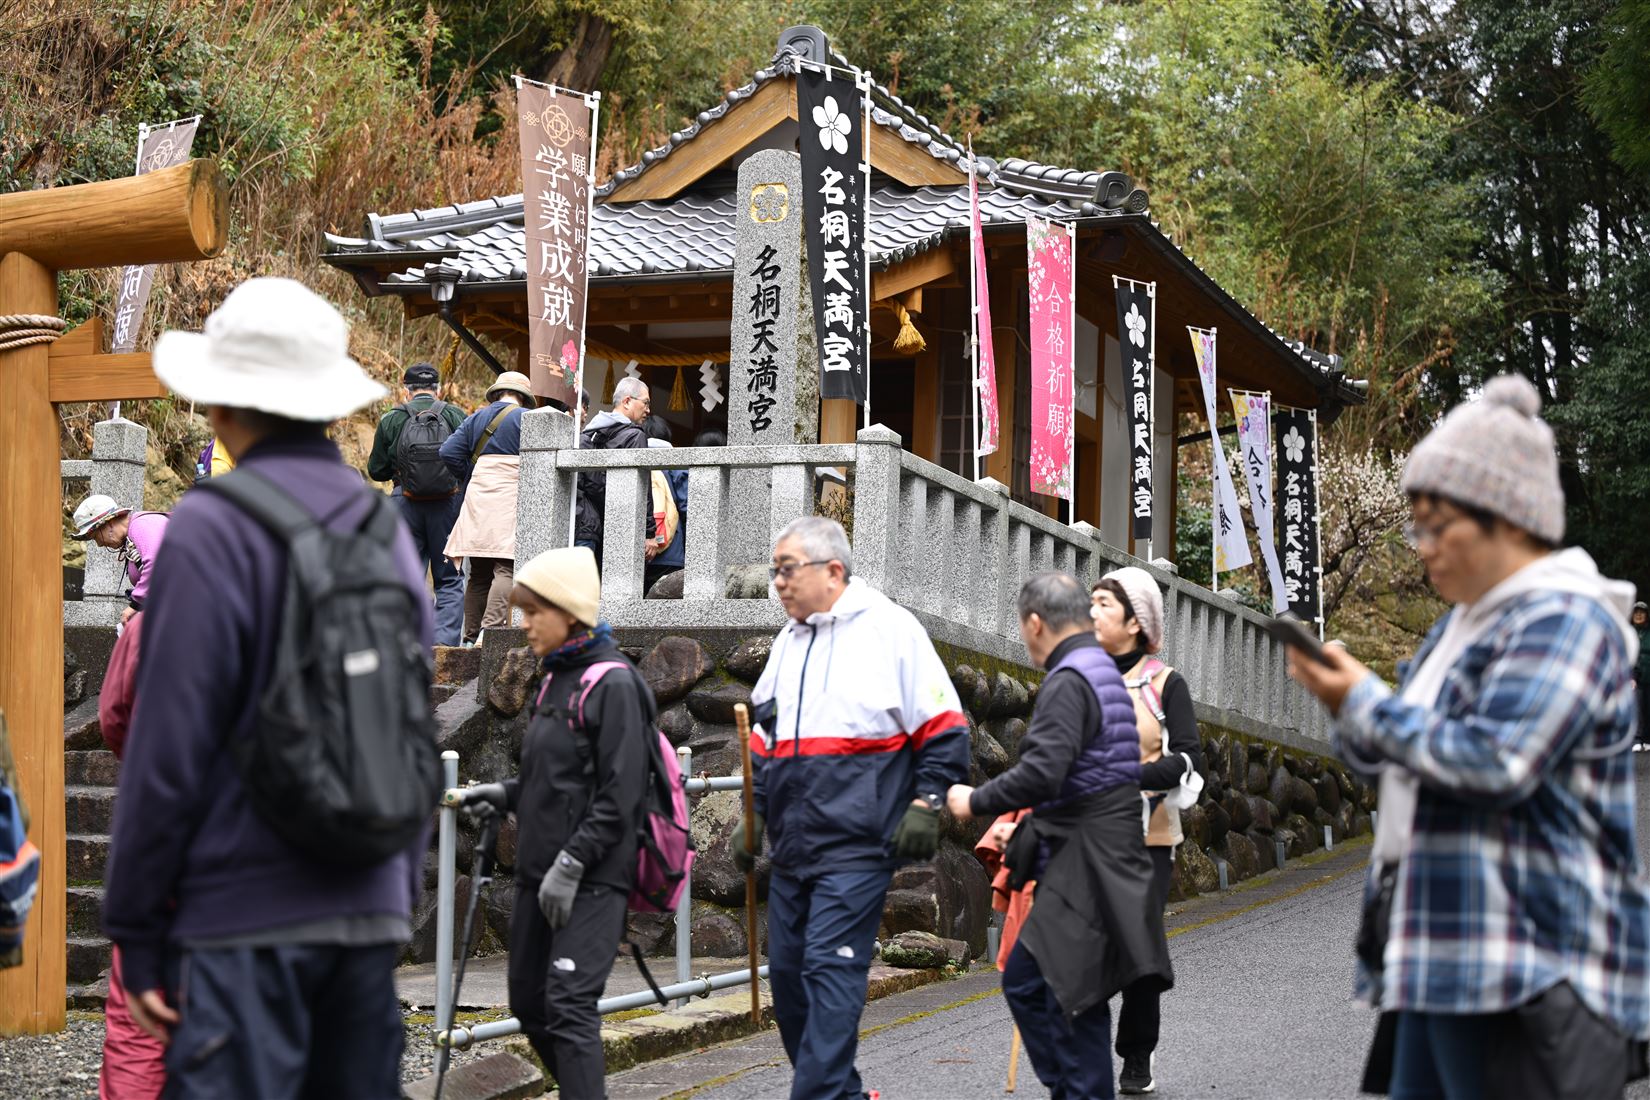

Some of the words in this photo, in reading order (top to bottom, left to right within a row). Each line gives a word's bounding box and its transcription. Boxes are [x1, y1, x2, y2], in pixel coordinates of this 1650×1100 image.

[535, 144, 575, 332] 学業成就
[571, 152, 588, 275] 願いは叶う
[818, 165, 855, 373] 名桐天満宮
[746, 244, 782, 434] 名桐天満宮
[1044, 281, 1066, 439] 合格祈願
